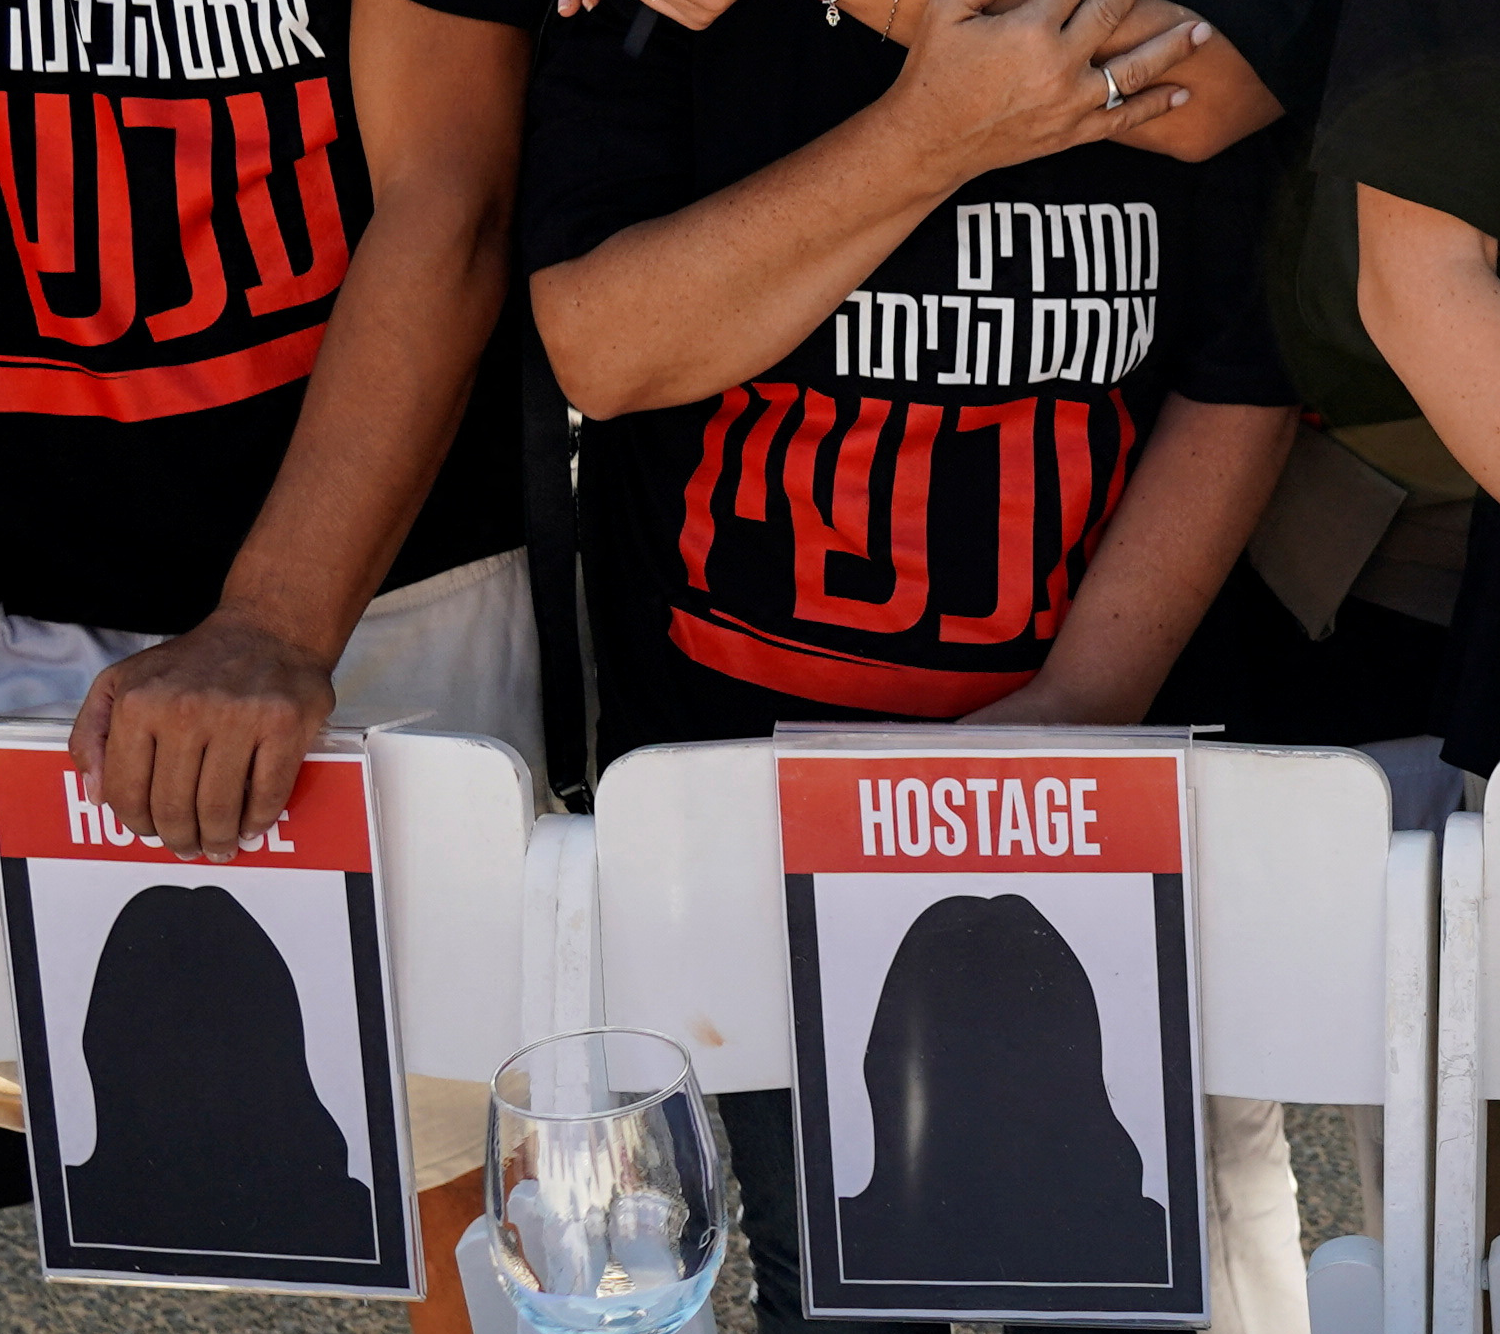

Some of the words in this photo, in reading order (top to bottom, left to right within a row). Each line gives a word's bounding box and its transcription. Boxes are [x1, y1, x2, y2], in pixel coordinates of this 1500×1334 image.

[956, 201, 1159, 293] מחזירים
[835, 289, 1015, 386] הביתה
[1027, 295, 1157, 385] אותם
[856, 776, 1102, 859] HOSTAGE
